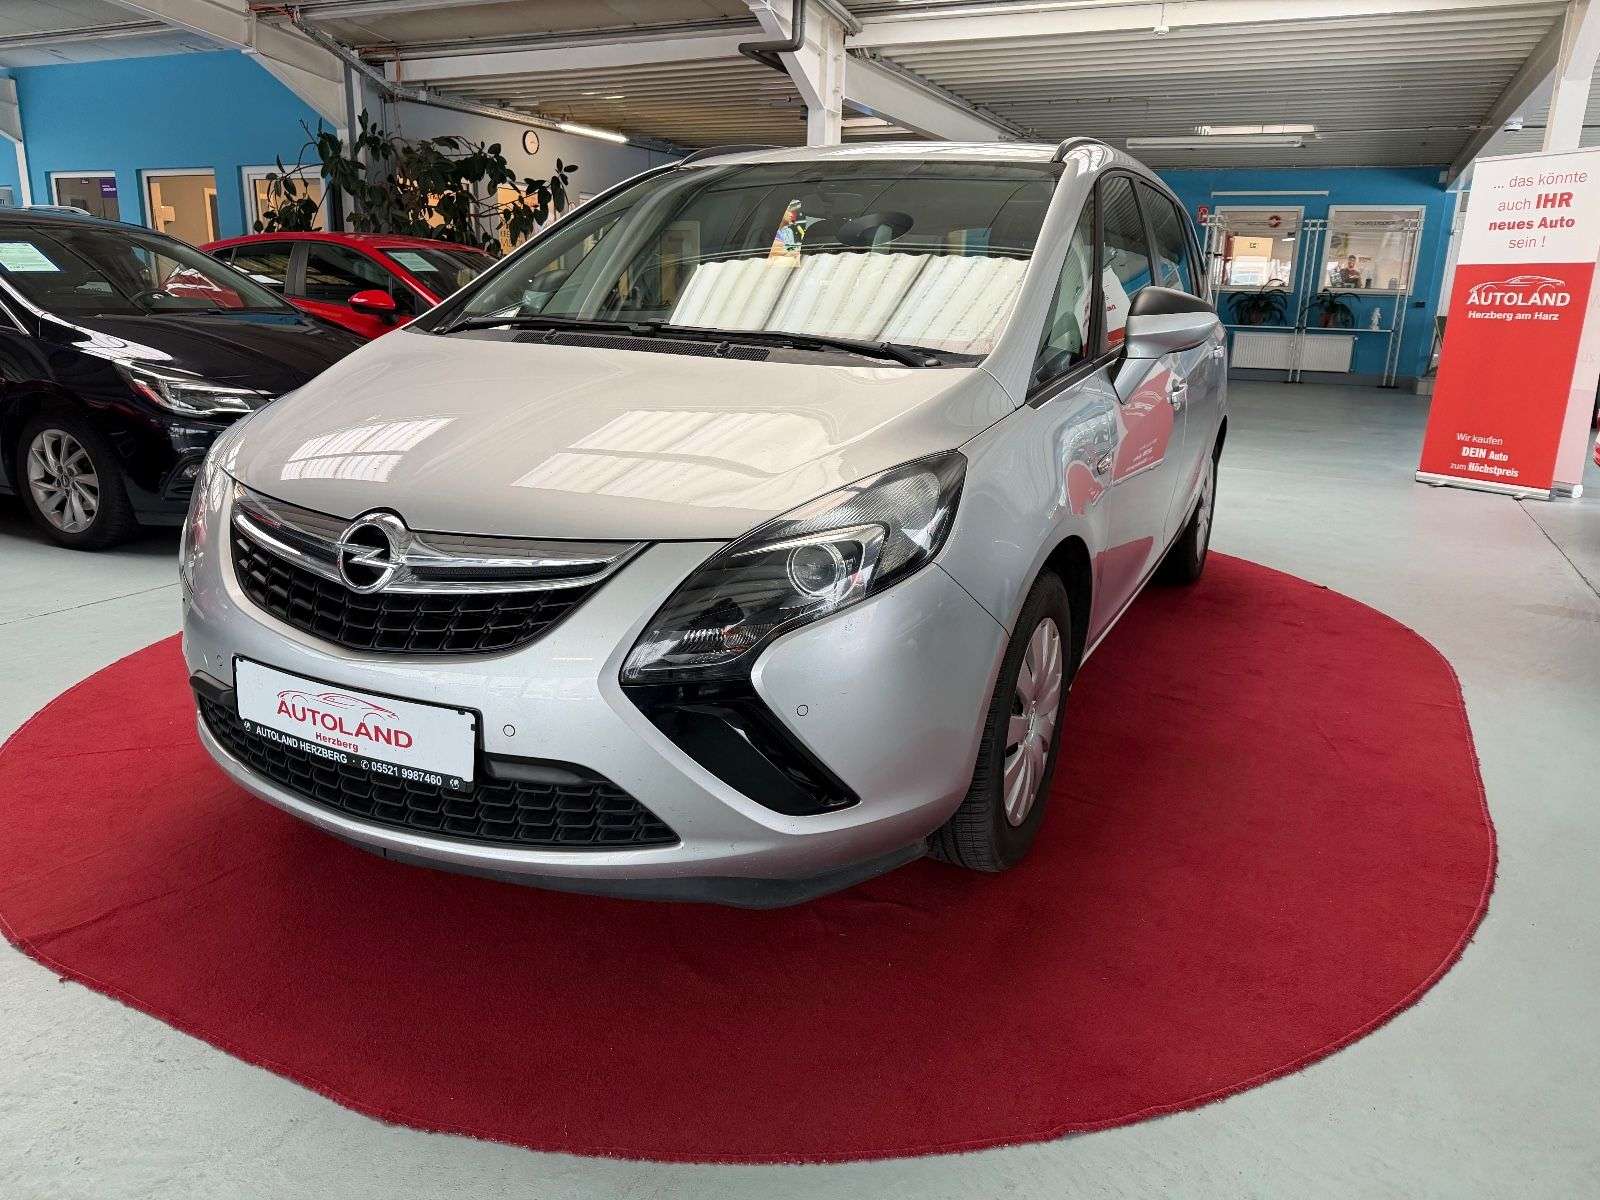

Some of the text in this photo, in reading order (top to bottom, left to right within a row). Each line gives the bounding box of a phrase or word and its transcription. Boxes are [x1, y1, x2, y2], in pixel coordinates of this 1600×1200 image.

[1509, 175, 1534, 188] das
[1538, 172, 1588, 186] könnte
[1497, 191, 1574, 212] auch IHR
[1488, 217, 1576, 231] neues Auto
[1508, 237, 1537, 249] sein
[1466, 291, 1571, 307] AUTOLAND
[1468, 310, 1513, 321] Herzberg
[1534, 312, 1559, 321] Harz
[1456, 433, 1503, 446] Wir kaufen
[1461, 446, 1509, 462] DEIN Auto
[1450, 462, 1519, 478] zum Höchstpreis
[276, 700, 413, 749] AUTOLAND
[315, 731, 359, 753] Herzberg
[255, 725, 442, 786] AUTOLAND HERZBERG 05521 9987460
